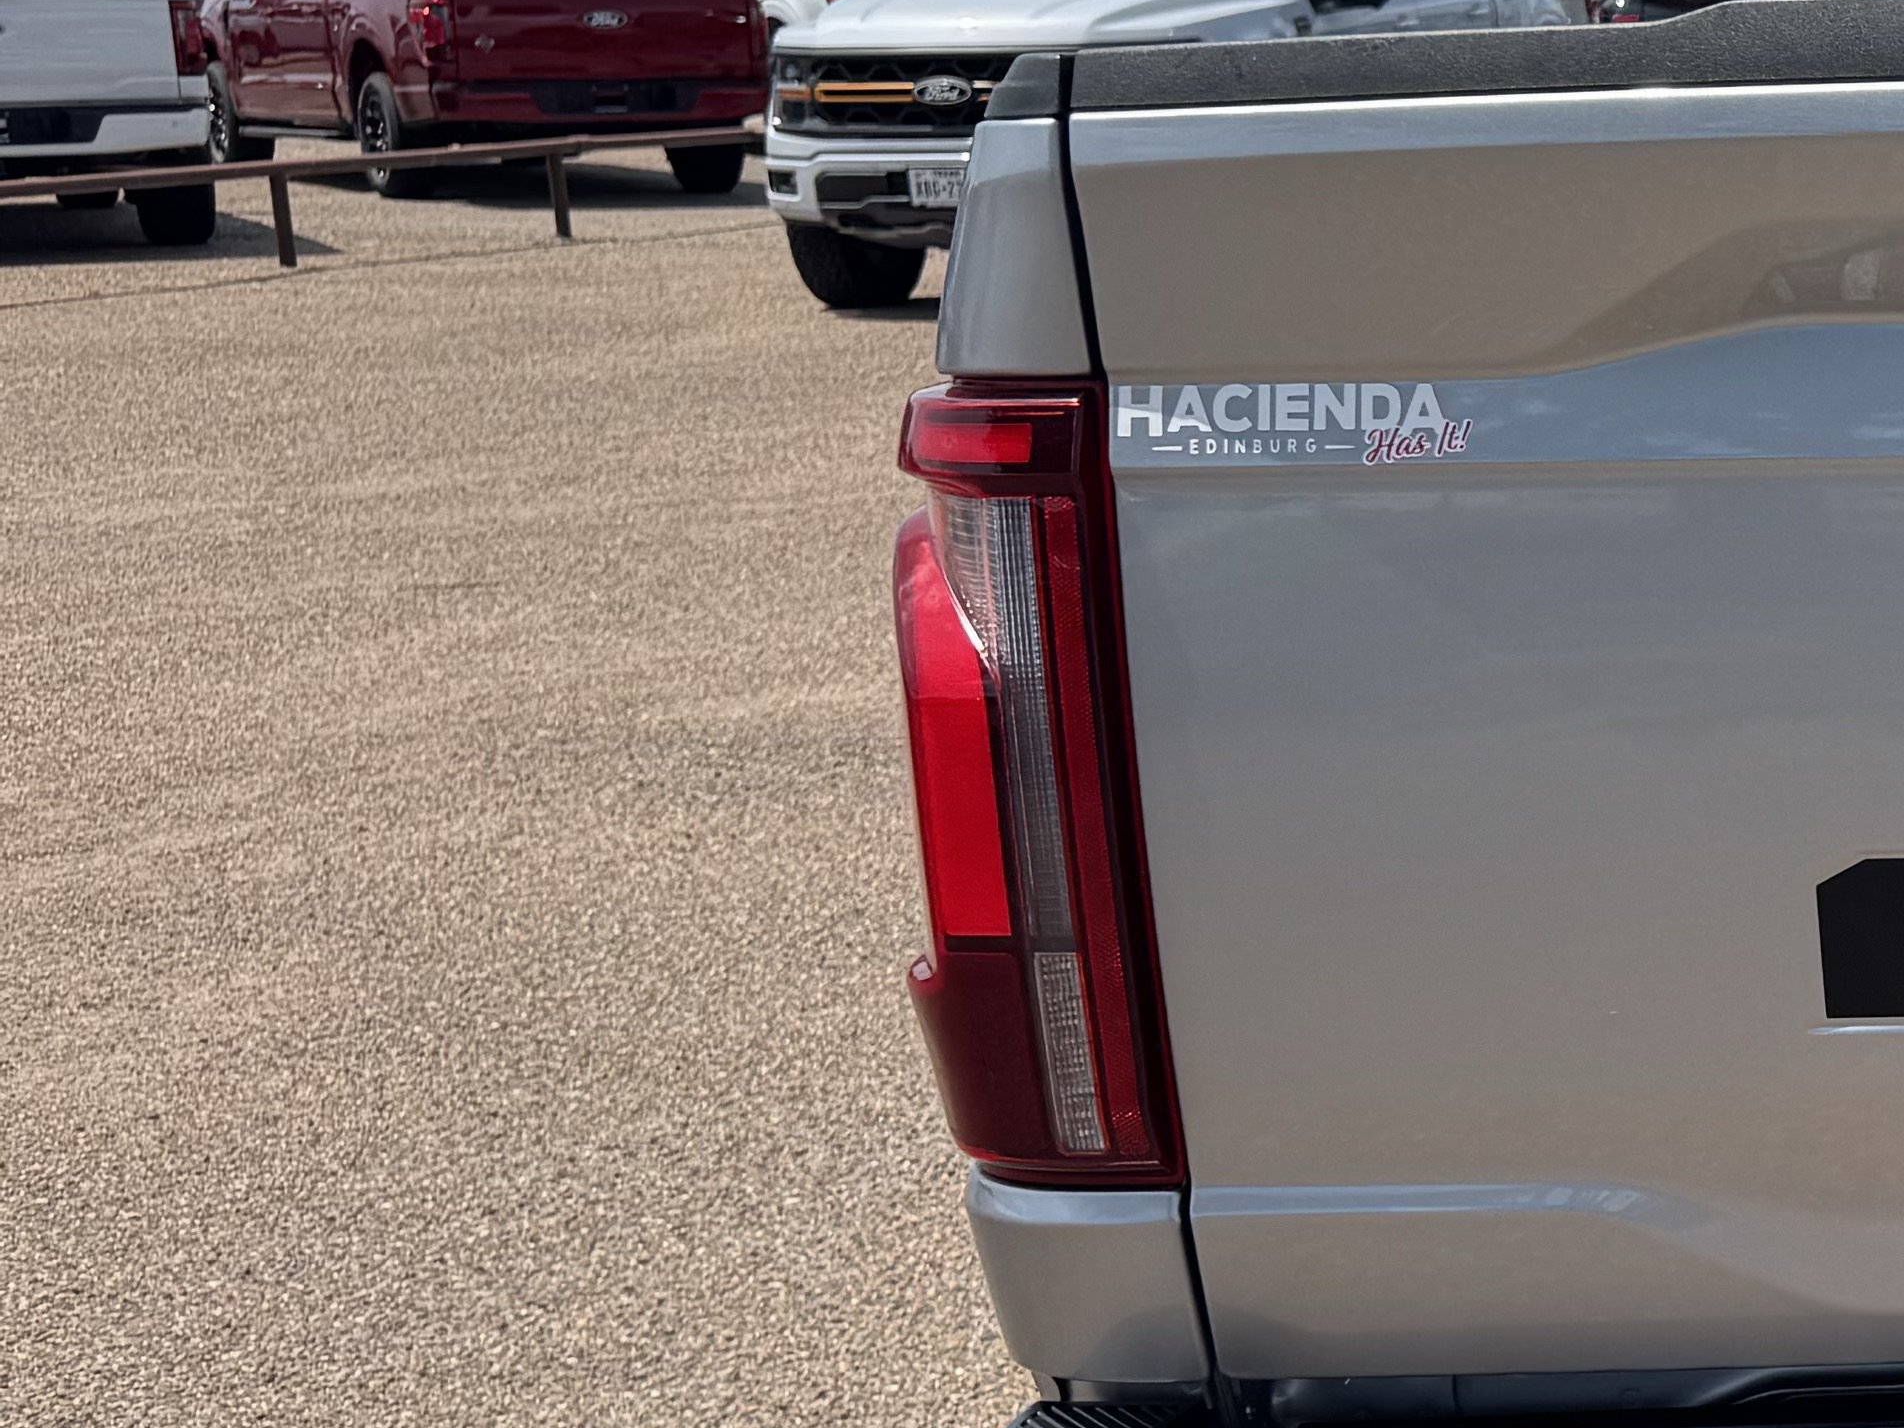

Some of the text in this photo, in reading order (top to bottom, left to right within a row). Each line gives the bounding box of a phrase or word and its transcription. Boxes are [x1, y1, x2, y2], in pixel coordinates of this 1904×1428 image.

[1116, 382, 1445, 438] HACIENDA
[1188, 437, 1317, 456] EDINBURG
[1363, 419, 1473, 466] Has It!
